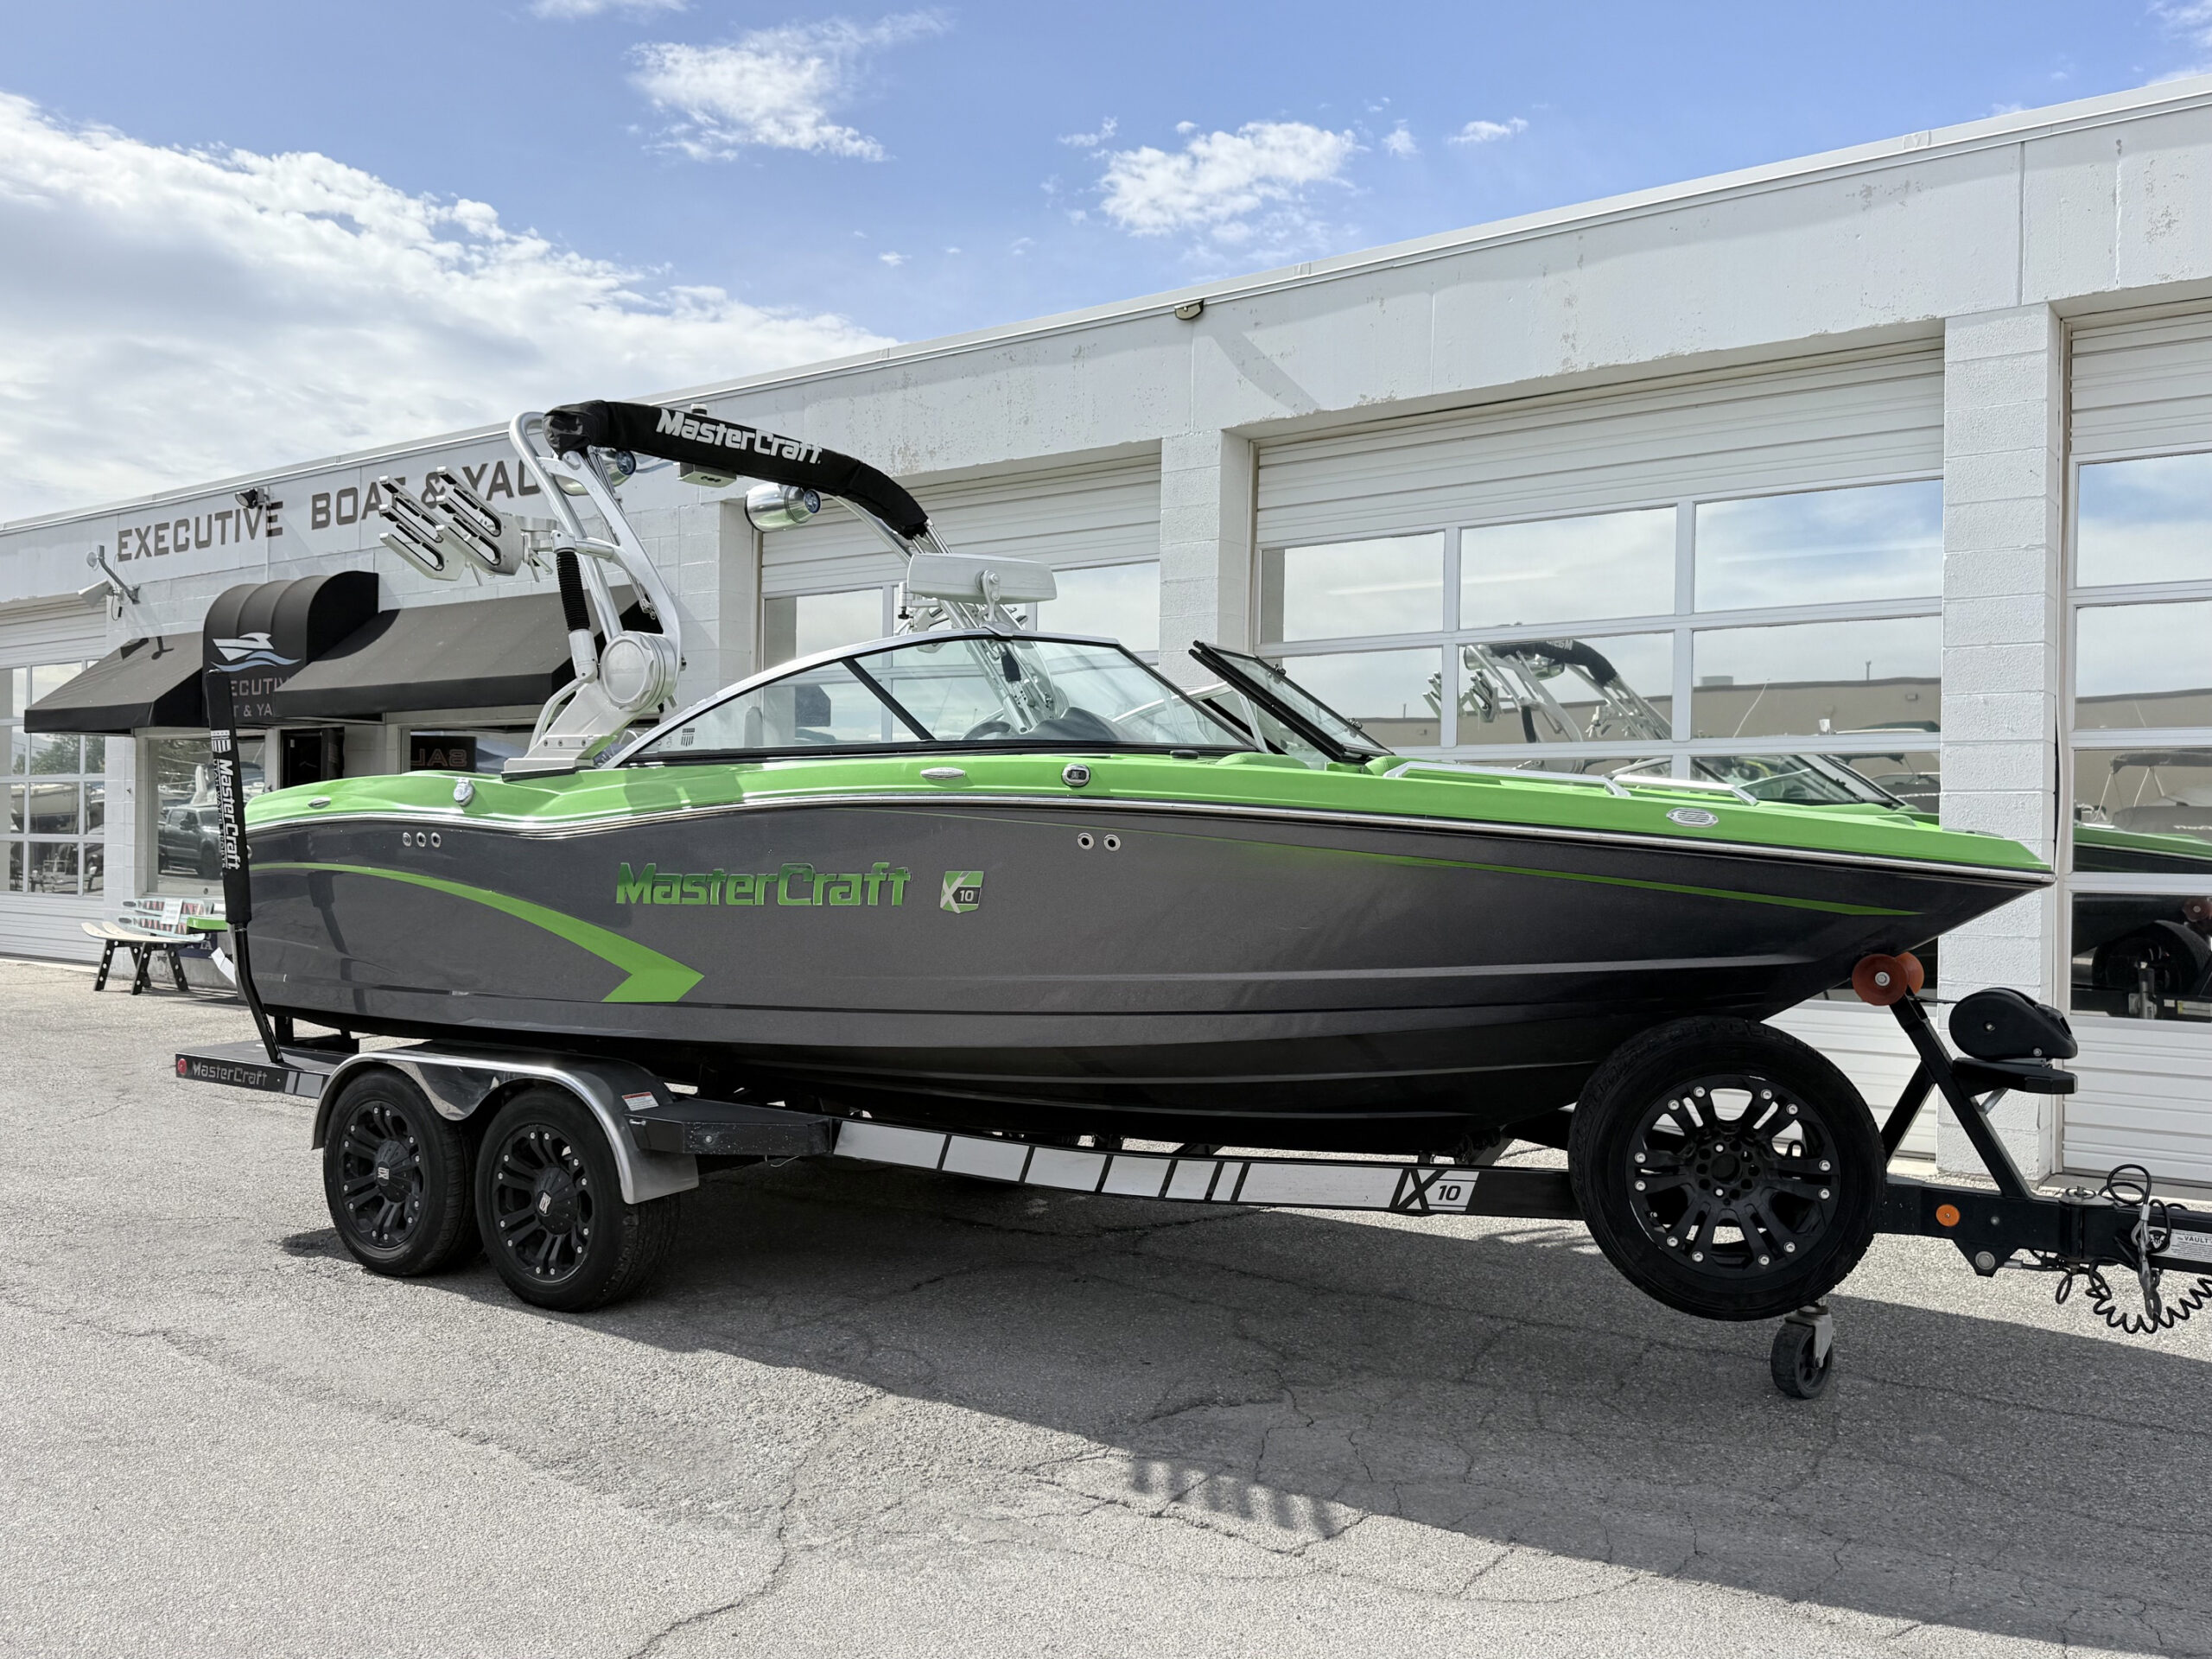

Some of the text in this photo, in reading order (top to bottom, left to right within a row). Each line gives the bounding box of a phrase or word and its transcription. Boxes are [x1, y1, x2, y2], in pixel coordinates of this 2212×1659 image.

[656, 408, 823, 464] MasterCraft
[118, 501, 283, 563] EXECUTIVE
[422, 472, 446, 510] &
[219, 759, 240, 869] MasterCraft
[616, 861, 912, 906] MasterCraft
[959, 890, 974, 902] 10
[192, 1061, 268, 1086] MasterCraft
[1438, 1185, 1461, 1201] 10
